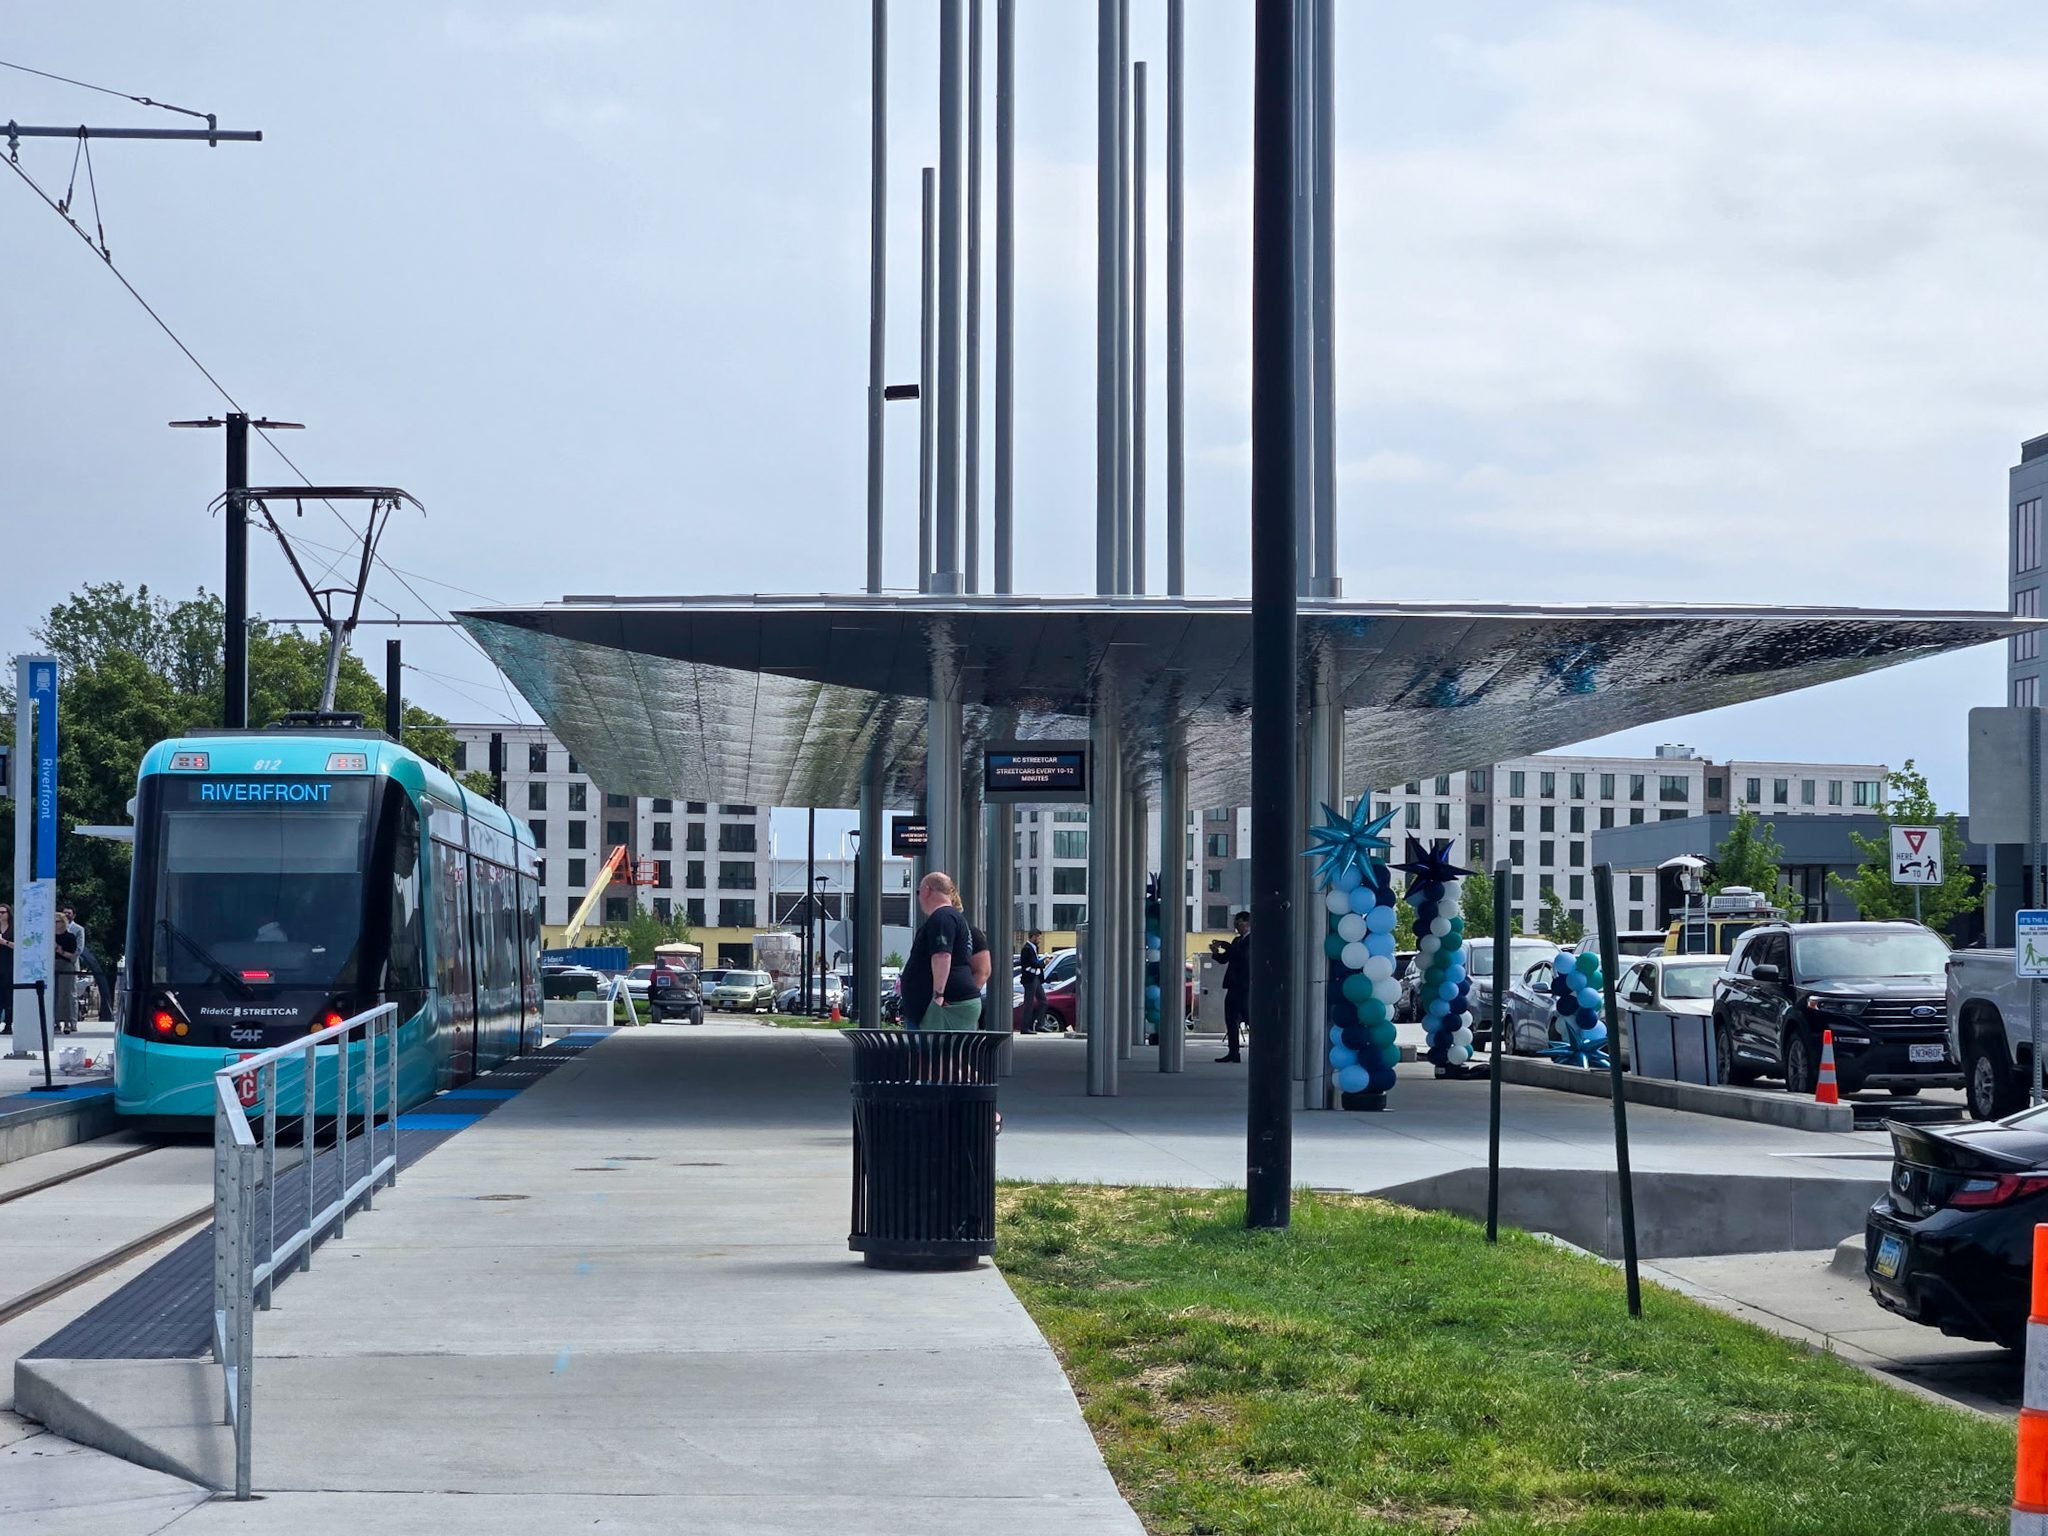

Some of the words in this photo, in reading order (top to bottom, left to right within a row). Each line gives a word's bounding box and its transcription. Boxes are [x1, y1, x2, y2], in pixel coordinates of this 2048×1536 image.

[254, 760, 282, 771] 812
[41, 758, 54, 819] Riverfront
[201, 783, 332, 801] RIVERFRONT
[1896, 852, 1913, 860] HERE
[200, 1007, 233, 1015] RideKC
[242, 1008, 298, 1016] STREETCAR
[230, 1029, 263, 1042] CAF
